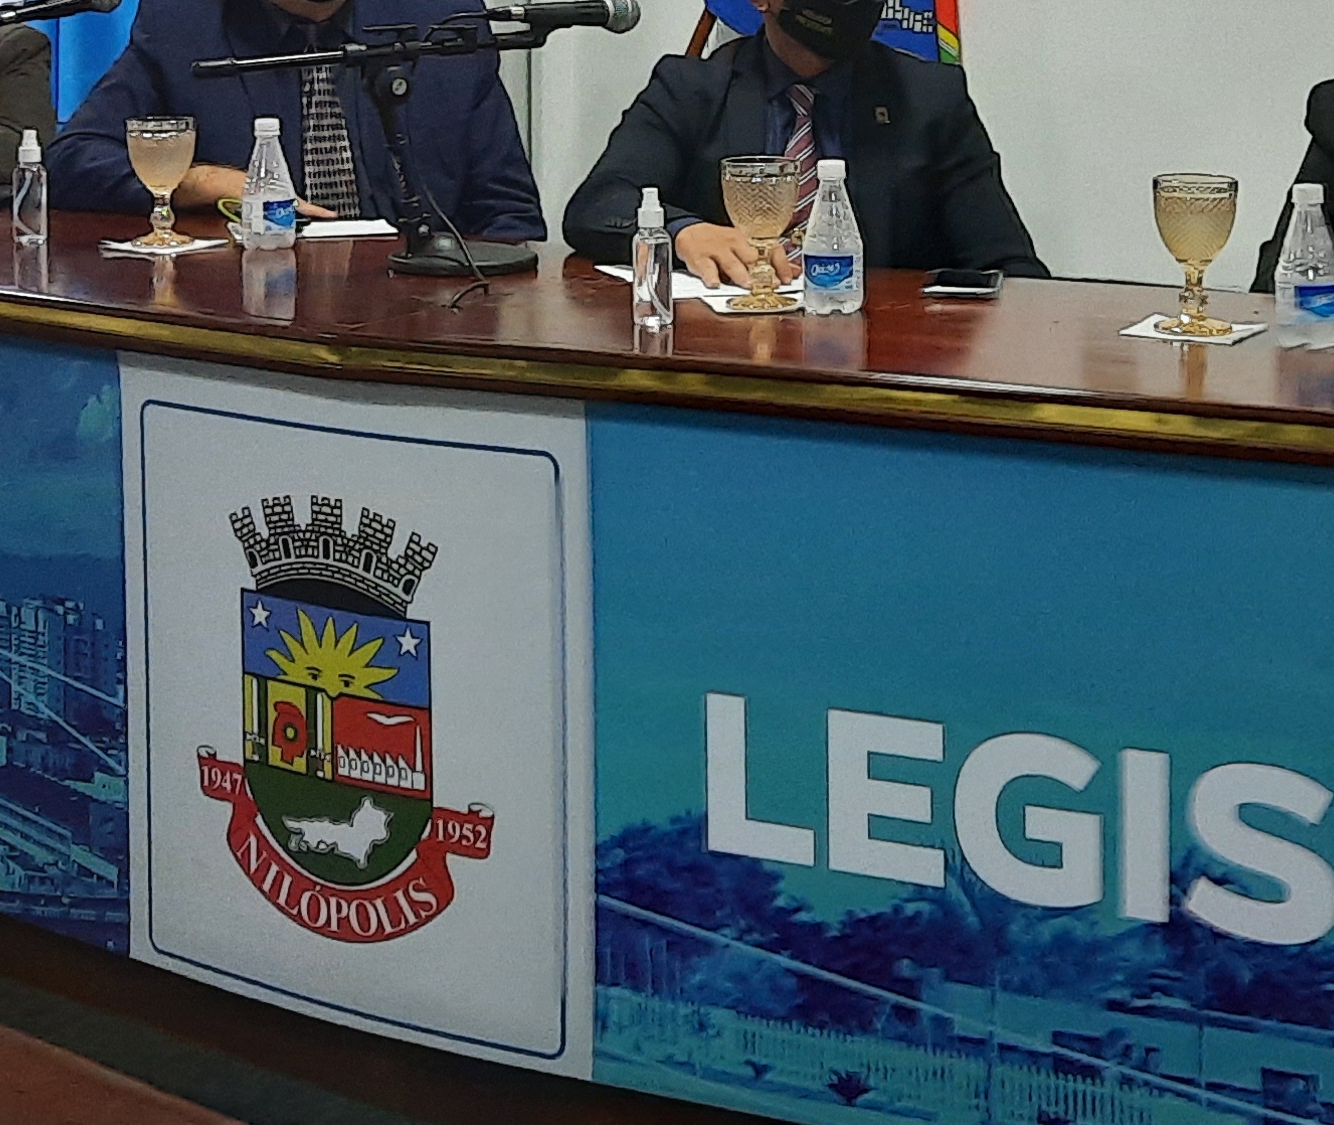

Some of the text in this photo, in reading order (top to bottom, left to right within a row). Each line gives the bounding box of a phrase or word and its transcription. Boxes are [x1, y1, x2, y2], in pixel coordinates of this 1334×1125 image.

[201, 765, 242, 795] 1947
[436, 818, 488, 848] 1952
[236, 832, 438, 937] NILÓPOLIS
